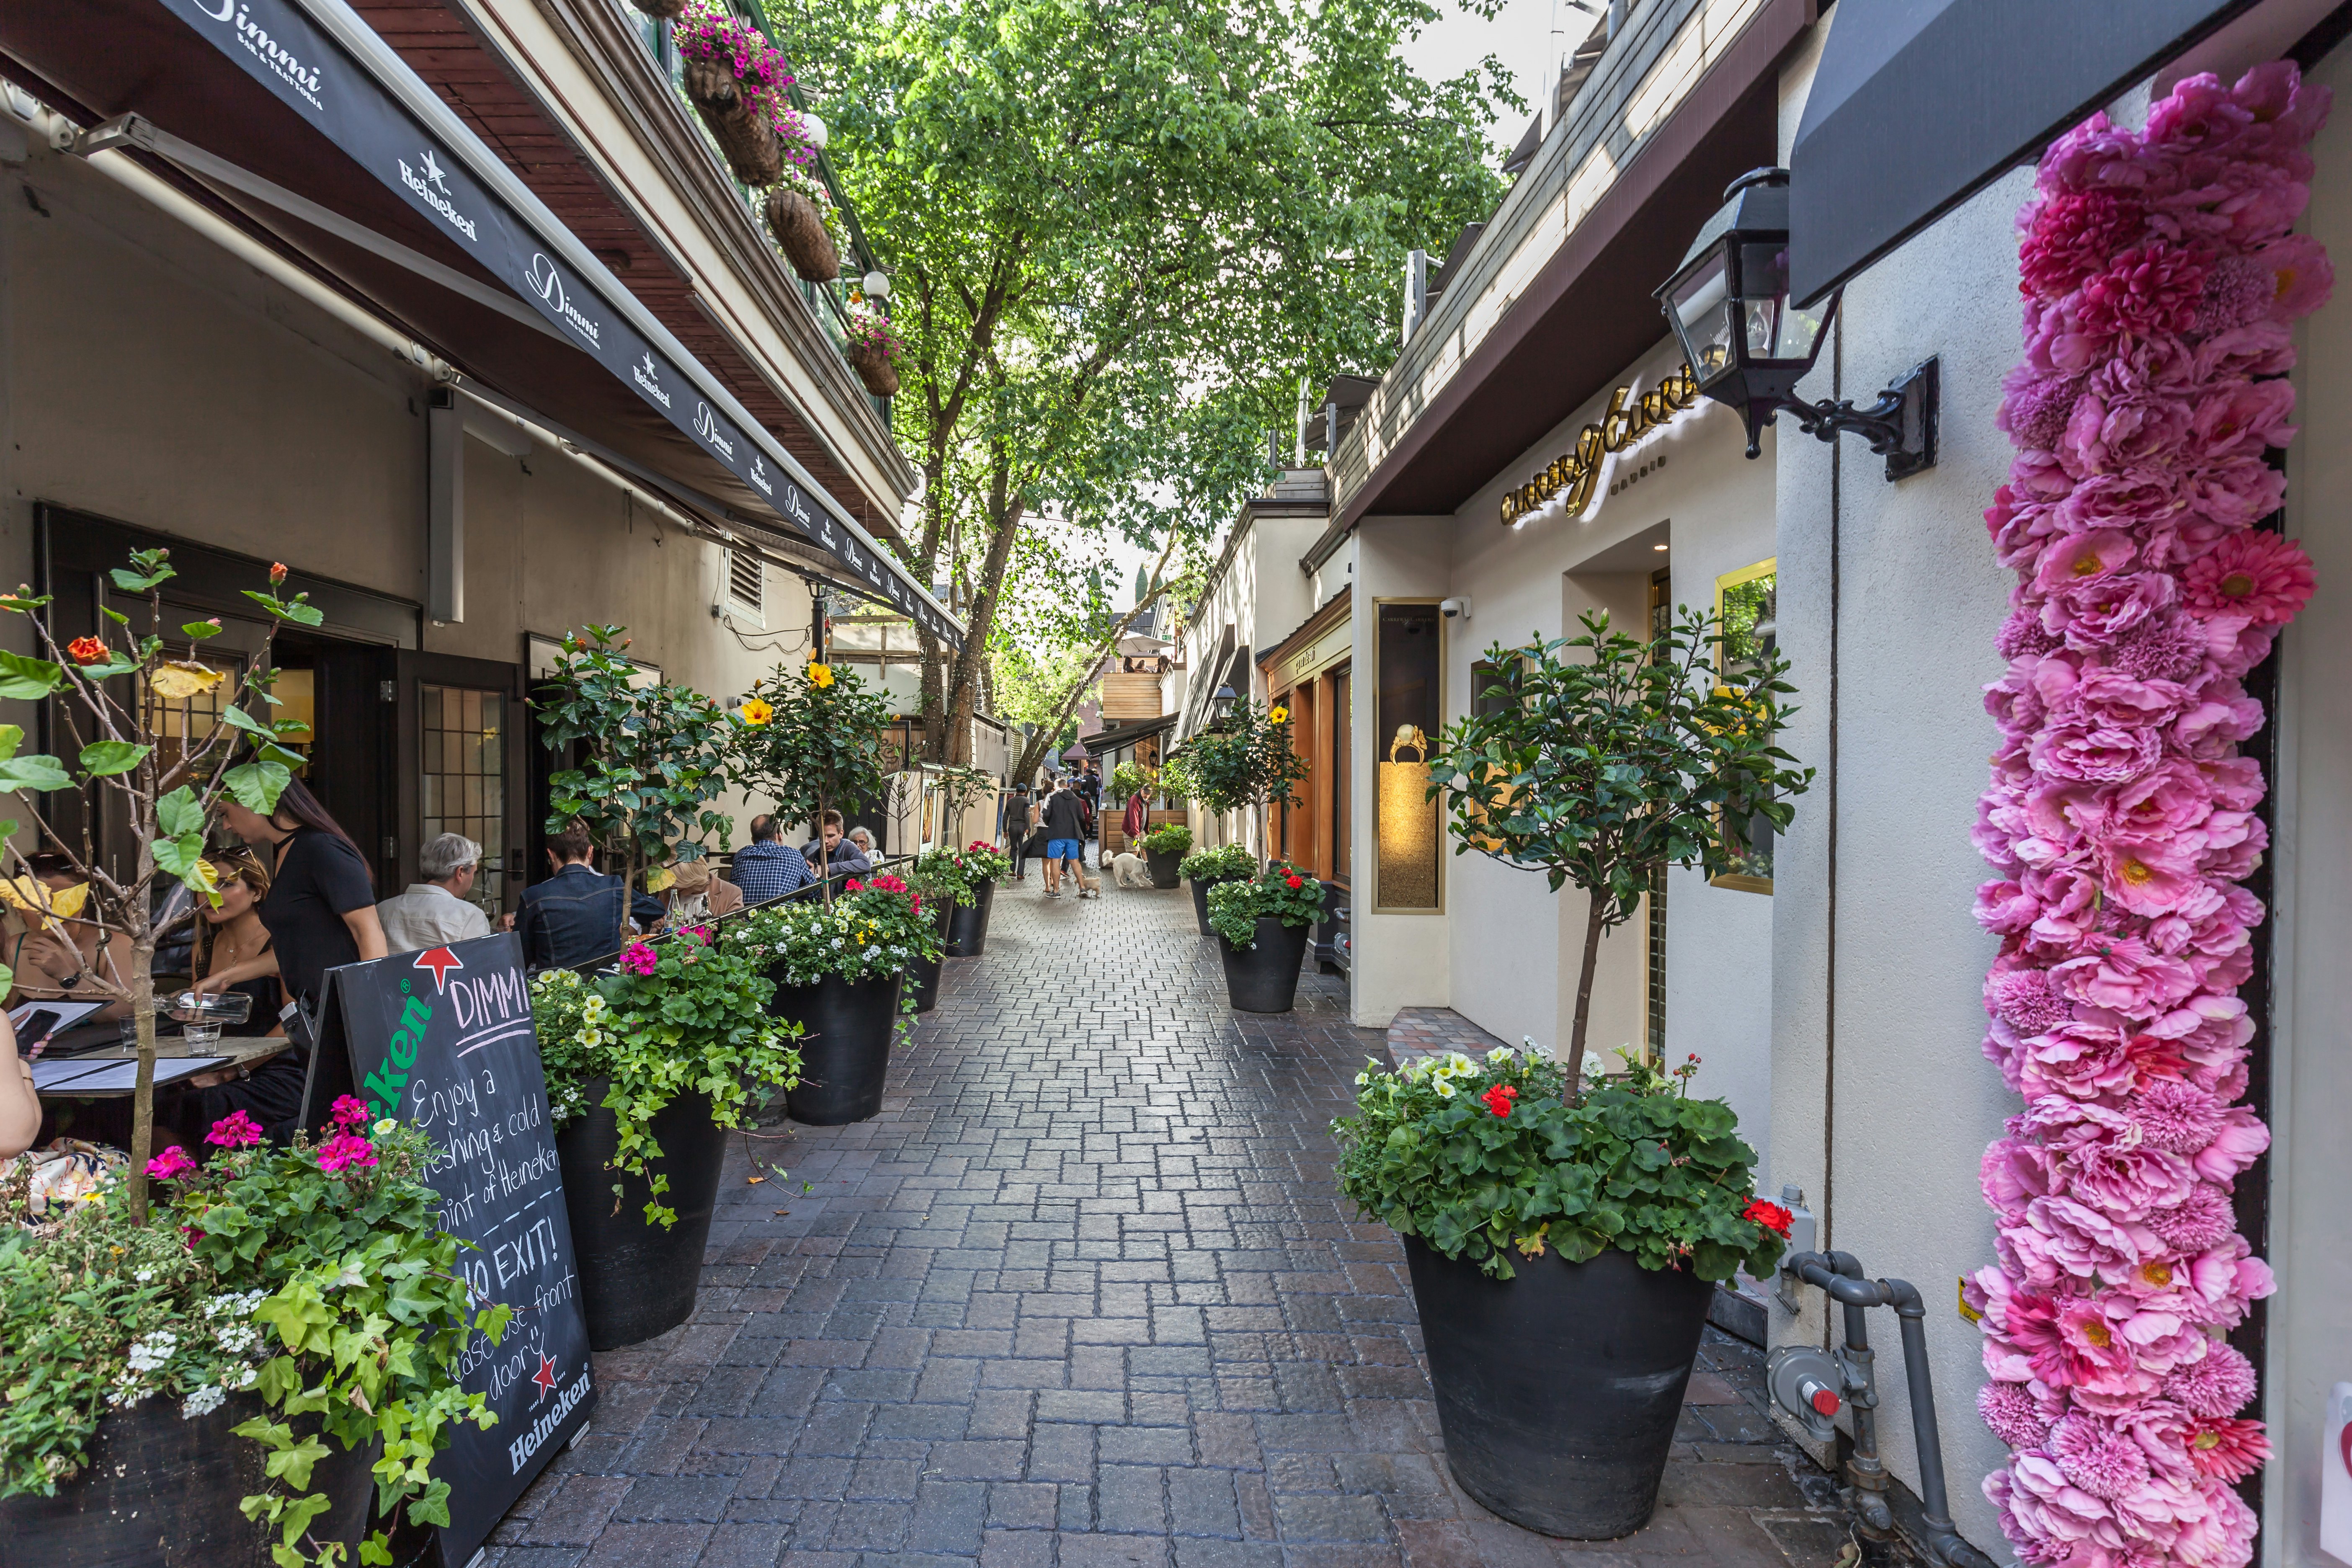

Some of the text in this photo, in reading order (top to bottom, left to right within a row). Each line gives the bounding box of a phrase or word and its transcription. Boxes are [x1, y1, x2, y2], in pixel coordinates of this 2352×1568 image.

[268, 59, 323, 111] TRATTORIA
[398, 159, 477, 242] Heineken
[525, 253, 599, 339] Dimmi
[633, 365, 671, 409] Heineken
[1603, 344, 1717, 453] CARRER
[693, 401, 733, 455] Dimmi
[449, 966, 530, 1029] DIMMI
[364, 995, 432, 1140] eken
[413, 1069, 496, 1127] Enjoy a
[493, 1123, 504, 1144] &
[508, 1093, 540, 1136] cold
[483, 1173, 497, 1204] of
[498, 1141, 560, 1197] Heineken
[493, 1215, 558, 1290] EXIT!
[534, 1264, 575, 1316] front
[490, 1345, 529, 1401] door
[557, 1370, 566, 1382] MARK
[508, 1372, 591, 1475] Heineken
[528, 1398, 539, 1413] TRADE
